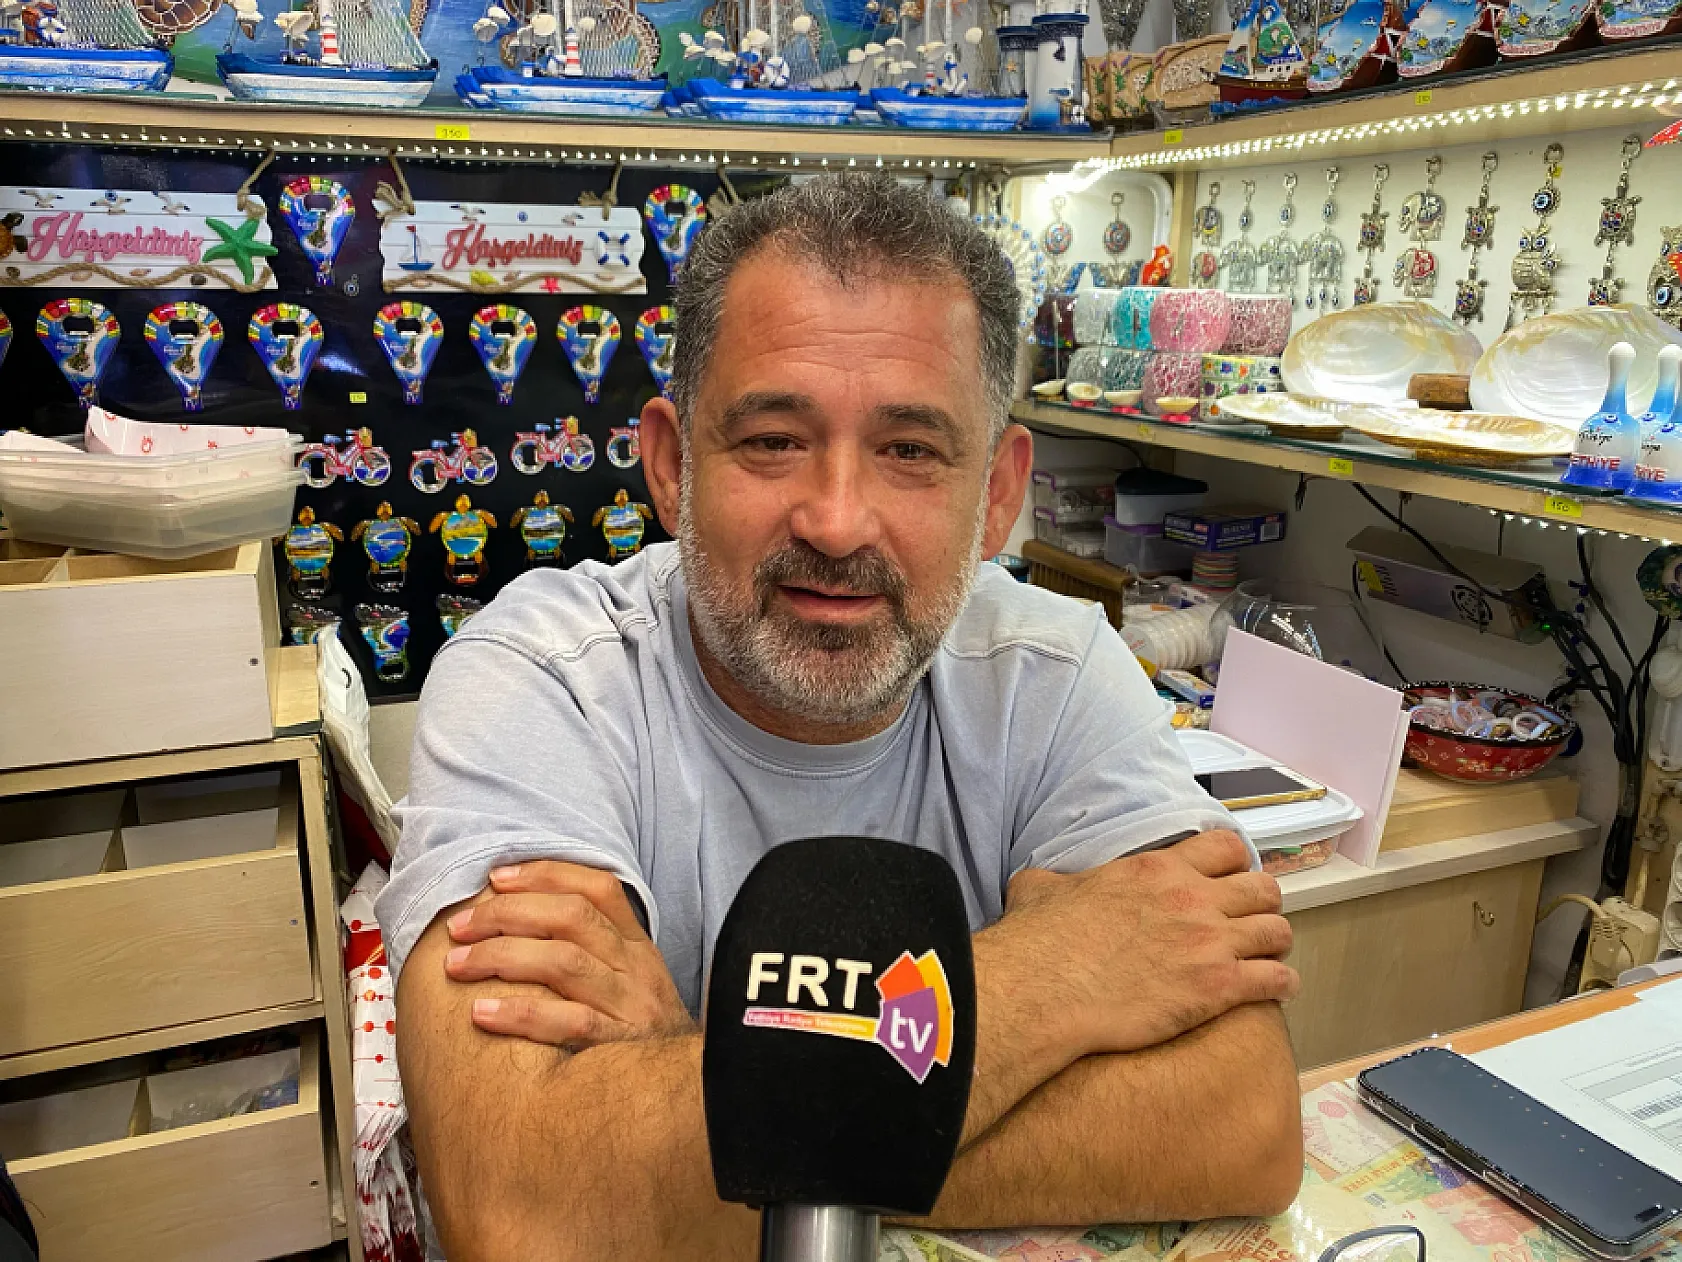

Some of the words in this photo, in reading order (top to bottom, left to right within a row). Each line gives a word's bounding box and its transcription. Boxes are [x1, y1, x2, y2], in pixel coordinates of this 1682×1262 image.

[27, 211, 204, 265] Hoşgeldiniz
[441, 223, 585, 271] Hoşgeldiniz
[747, 952, 873, 1010] FRT
[890, 1007, 934, 1053] tv
